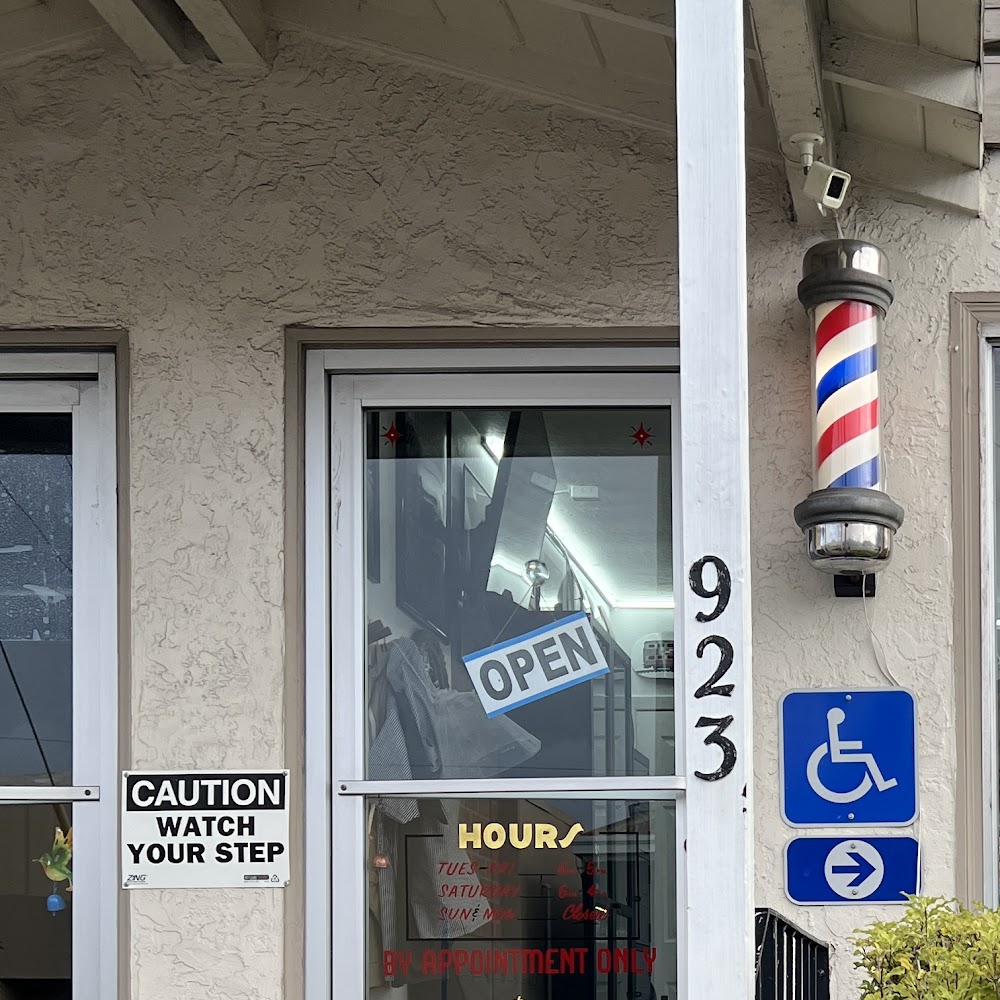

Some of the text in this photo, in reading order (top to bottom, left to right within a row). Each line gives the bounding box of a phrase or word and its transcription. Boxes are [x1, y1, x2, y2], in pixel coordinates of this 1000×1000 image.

[479, 626, 598, 701] OPEN
[689, 555, 738, 782] 923
[131, 779, 281, 807] CAUTION
[155, 816, 256, 837] WATCH
[458, 823, 584, 849] HOURS
[127, 842, 285, 864] YOUR STEP
[382, 947, 657, 977] BY APPOINTMENT ONLY
